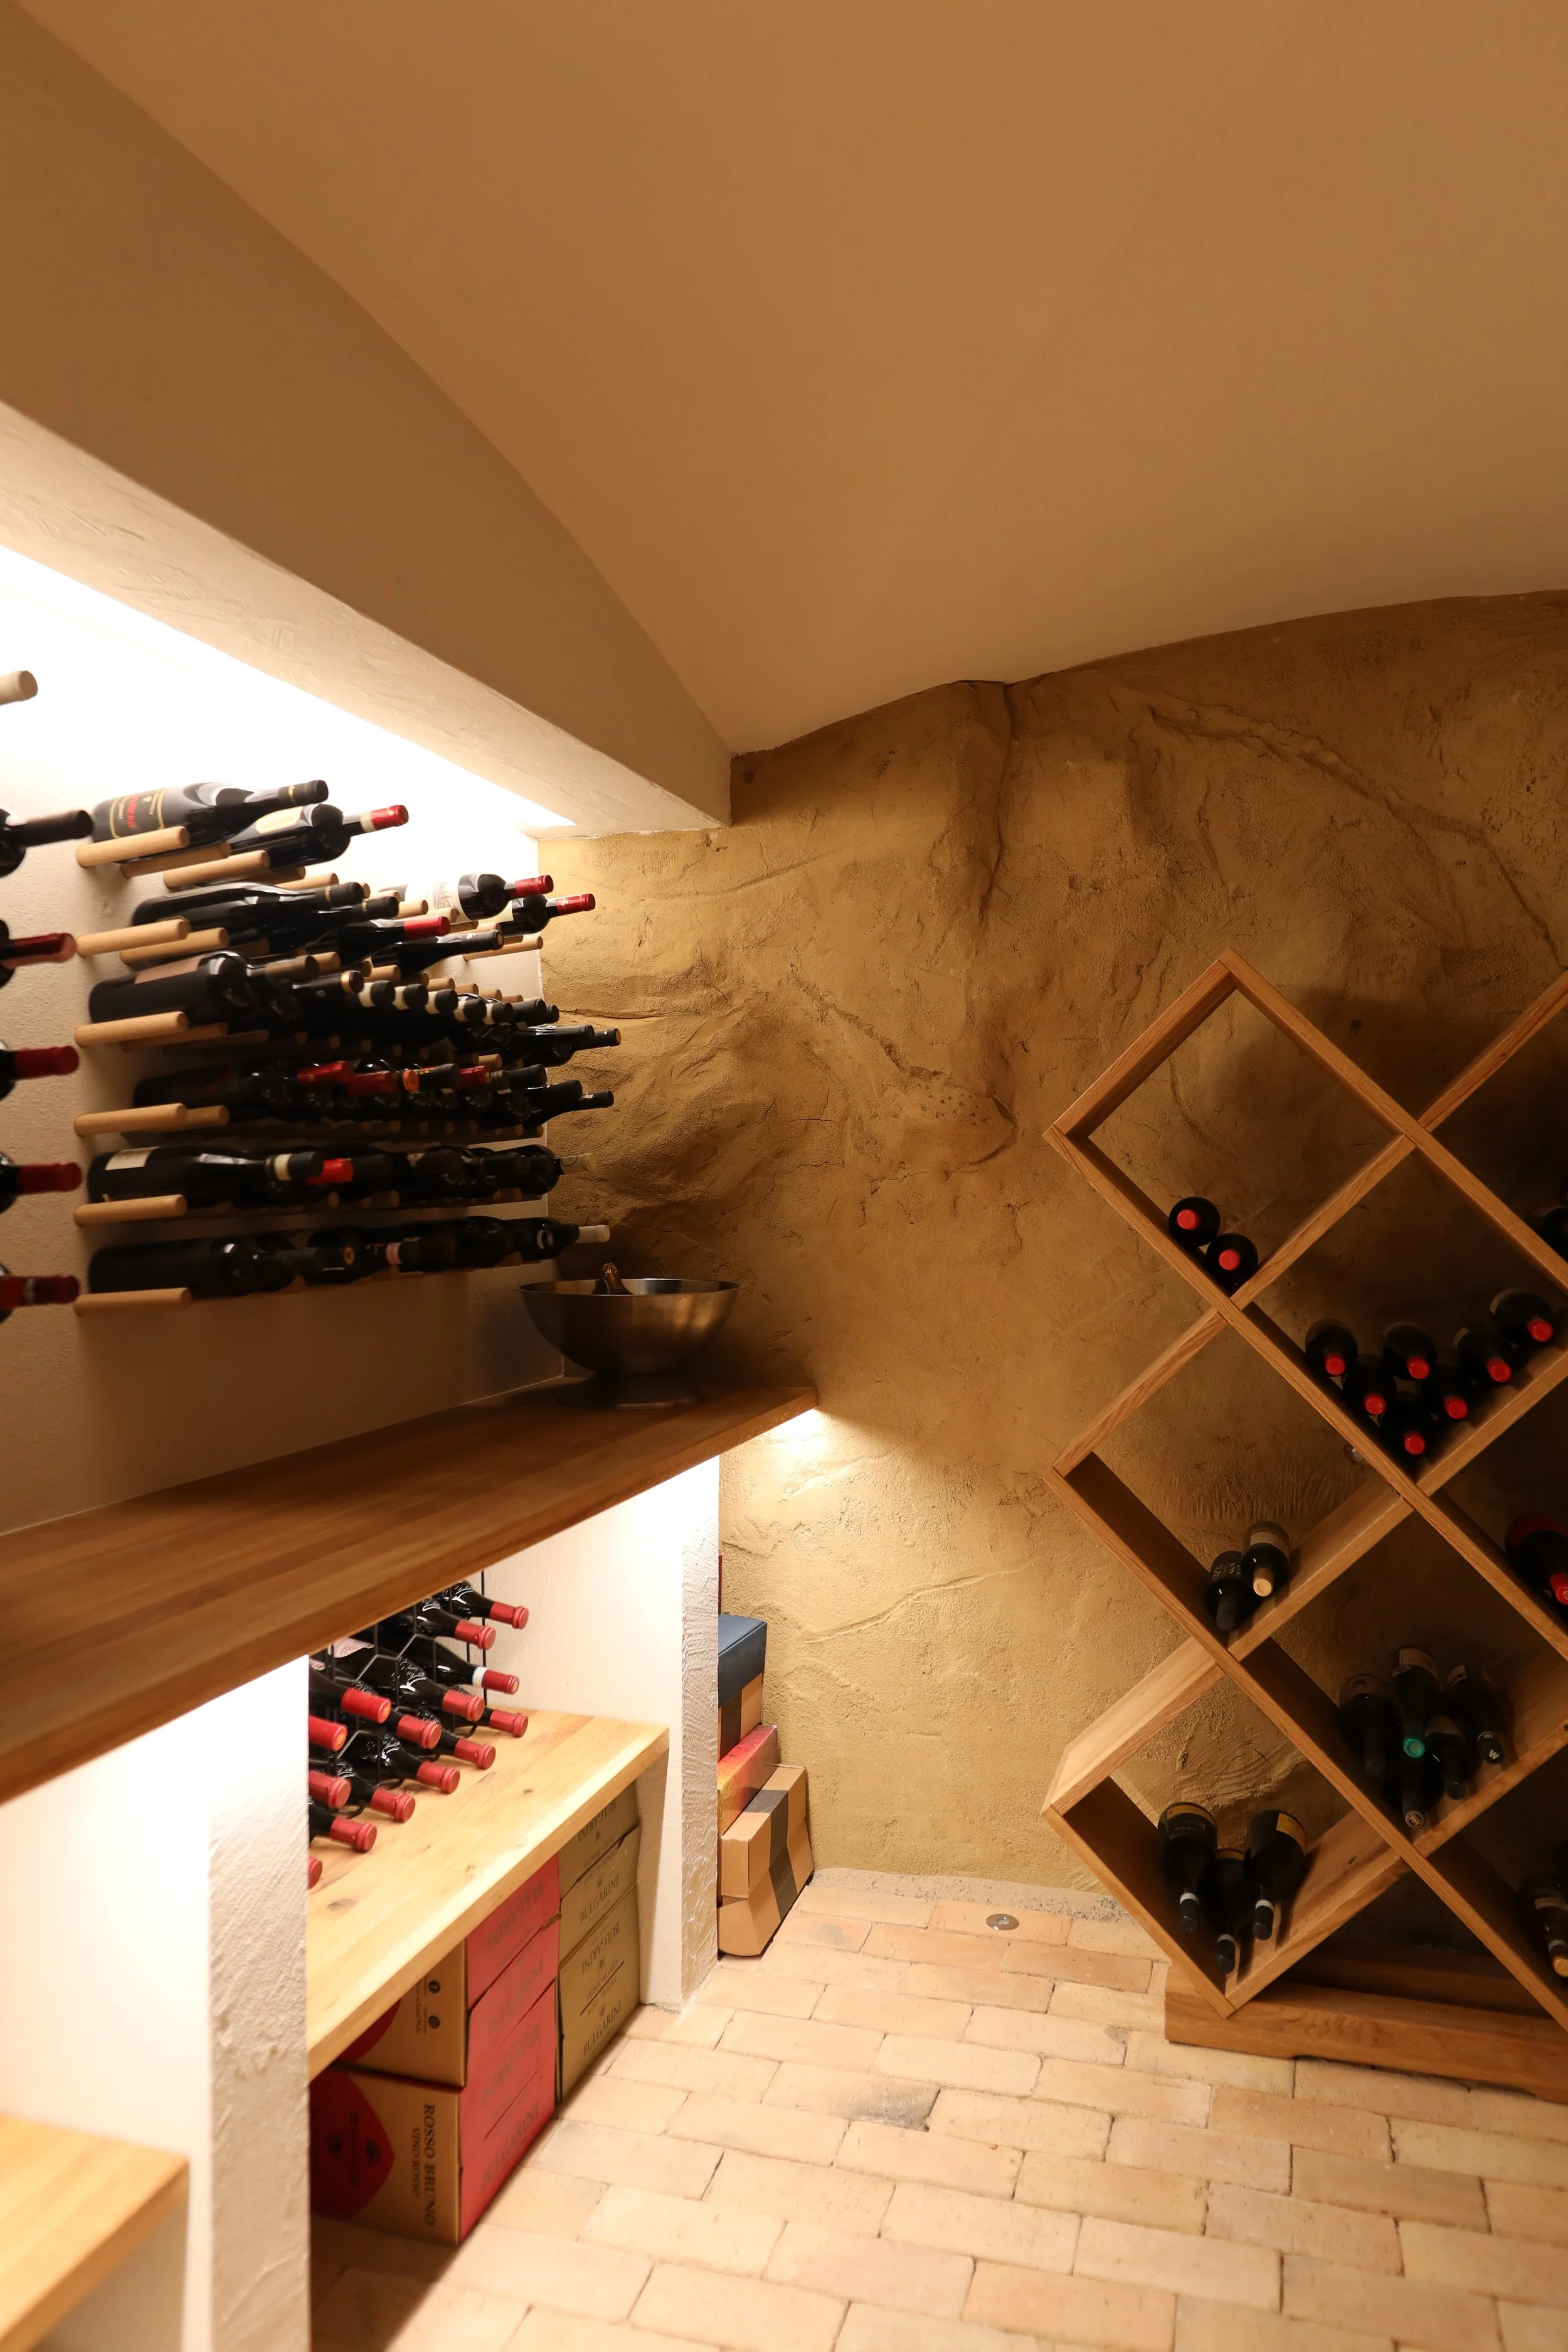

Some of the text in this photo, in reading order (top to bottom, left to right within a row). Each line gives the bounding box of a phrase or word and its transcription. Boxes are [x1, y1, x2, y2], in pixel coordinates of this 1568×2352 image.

[580, 1876, 618, 1924] BULGARINI
[582, 1922, 619, 1974] BULGARINI
[583, 2001, 621, 2057] BULGARINI
[412, 2161, 420, 2198] ROSSO
[424, 2104, 436, 2226] ROSSO BRUNO
